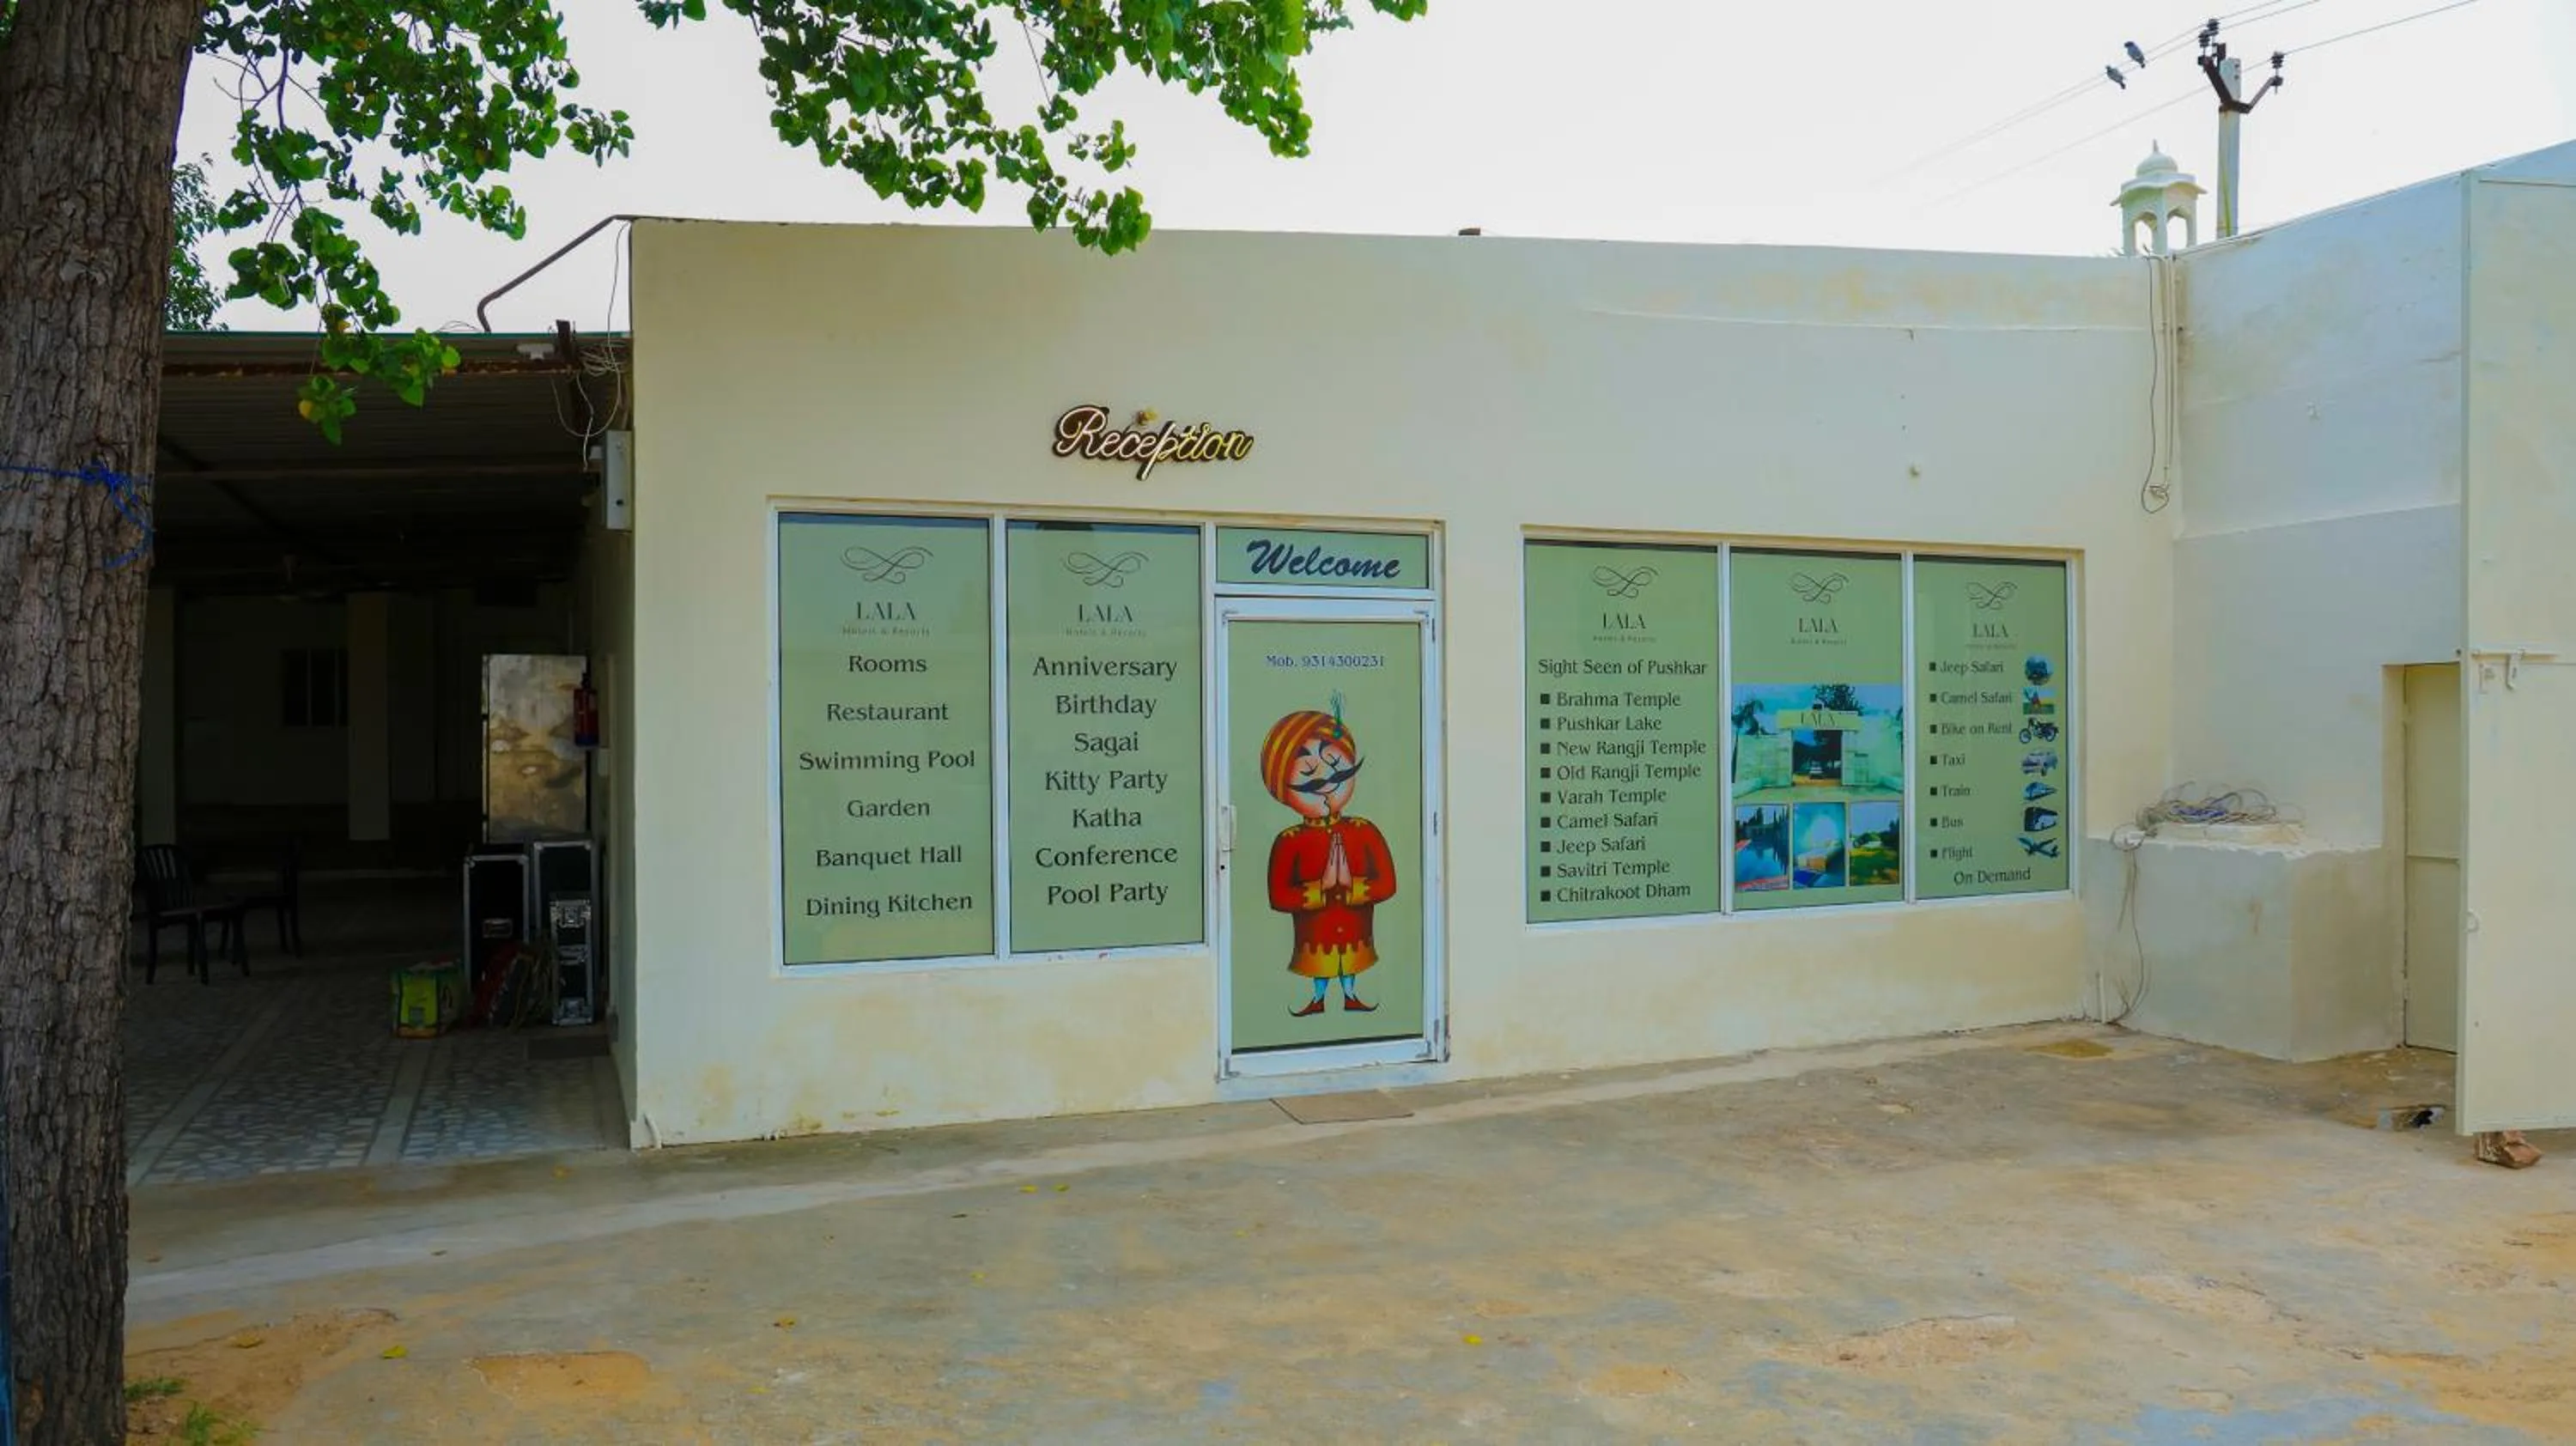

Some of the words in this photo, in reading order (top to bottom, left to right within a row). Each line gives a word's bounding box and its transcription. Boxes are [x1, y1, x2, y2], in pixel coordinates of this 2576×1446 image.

[1052, 404, 1255, 482] Reception
[1246, 538, 1401, 579] Welcome
[856, 601, 916, 621] LALA
[1078, 604, 1133, 623] LALA
[1603, 612, 1646, 629] LALA
[1799, 617, 1838, 634] LALA
[1972, 623, 2009, 639] LALA
[848, 655, 927, 673] Rooms
[1032, 655, 1177, 682] Anniversary
[1266, 655, 1298, 668] Mob.
[1538, 659, 1578, 678] Sight
[1583, 659, 1622, 675] Seen
[1627, 659, 1644, 674] of
[1648, 659, 1707, 675] Pushkar
[1940, 660, 1970, 677] Jeep
[1971, 660, 2004, 674] Safari
[1055, 694, 1157, 720] Birthday
[1557, 691, 1619, 708] Brahma
[1624, 691, 1681, 711] Temple
[1940, 690, 1978, 705] Camel
[1980, 691, 2013, 704] Safari
[827, 702, 949, 722] Restaurant
[1557, 715, 1619, 732] Pushkar
[1625, 715, 1662, 731] Lake
[1941, 722, 1966, 736] Bike
[1969, 725, 1984, 735] on
[1987, 720, 2013, 735] Rent
[1074, 731, 1139, 757] Sagai
[1557, 741, 1591, 756] New
[1596, 739, 1644, 759] Rangji
[1650, 739, 1707, 758] Temple
[799, 750, 920, 774] Swimming
[928, 750, 975, 769] Pool
[1942, 753, 1965, 767] Taxi
[1045, 769, 1100, 796] Kitty
[1109, 769, 1169, 794] Party
[1557, 764, 1585, 781] Old
[1591, 763, 1639, 784] Rangji
[1644, 763, 1701, 782] Temple
[1557, 789, 1603, 805] Varah
[1608, 787, 1668, 806] Temple
[1942, 784, 1971, 798] Train
[847, 799, 930, 818] Garden
[1072, 807, 1142, 829] Katha
[1557, 813, 1609, 829] Camel
[1613, 811, 1658, 828] Safari
[1941, 816, 1964, 829] Bus
[1556, 839, 1596, 857] Jeep
[1601, 835, 1646, 853] Safari
[1941, 846, 1973, 862] Flight
[816, 848, 911, 871] Banquet
[920, 844, 963, 864] Hall
[1035, 844, 1177, 868] Conference
[1557, 861, 1607, 878] Savitri
[1612, 859, 1670, 878] Temple
[1953, 871, 1973, 886] On
[1977, 866, 2032, 884] Demand
[1048, 884, 1100, 906] Pool
[1110, 882, 1169, 906] Party
[1557, 885, 1640, 902] Chitrakoot
[1645, 883, 1691, 898] Dham
[806, 896, 880, 920] Dining
[888, 893, 973, 913] Kitchen
